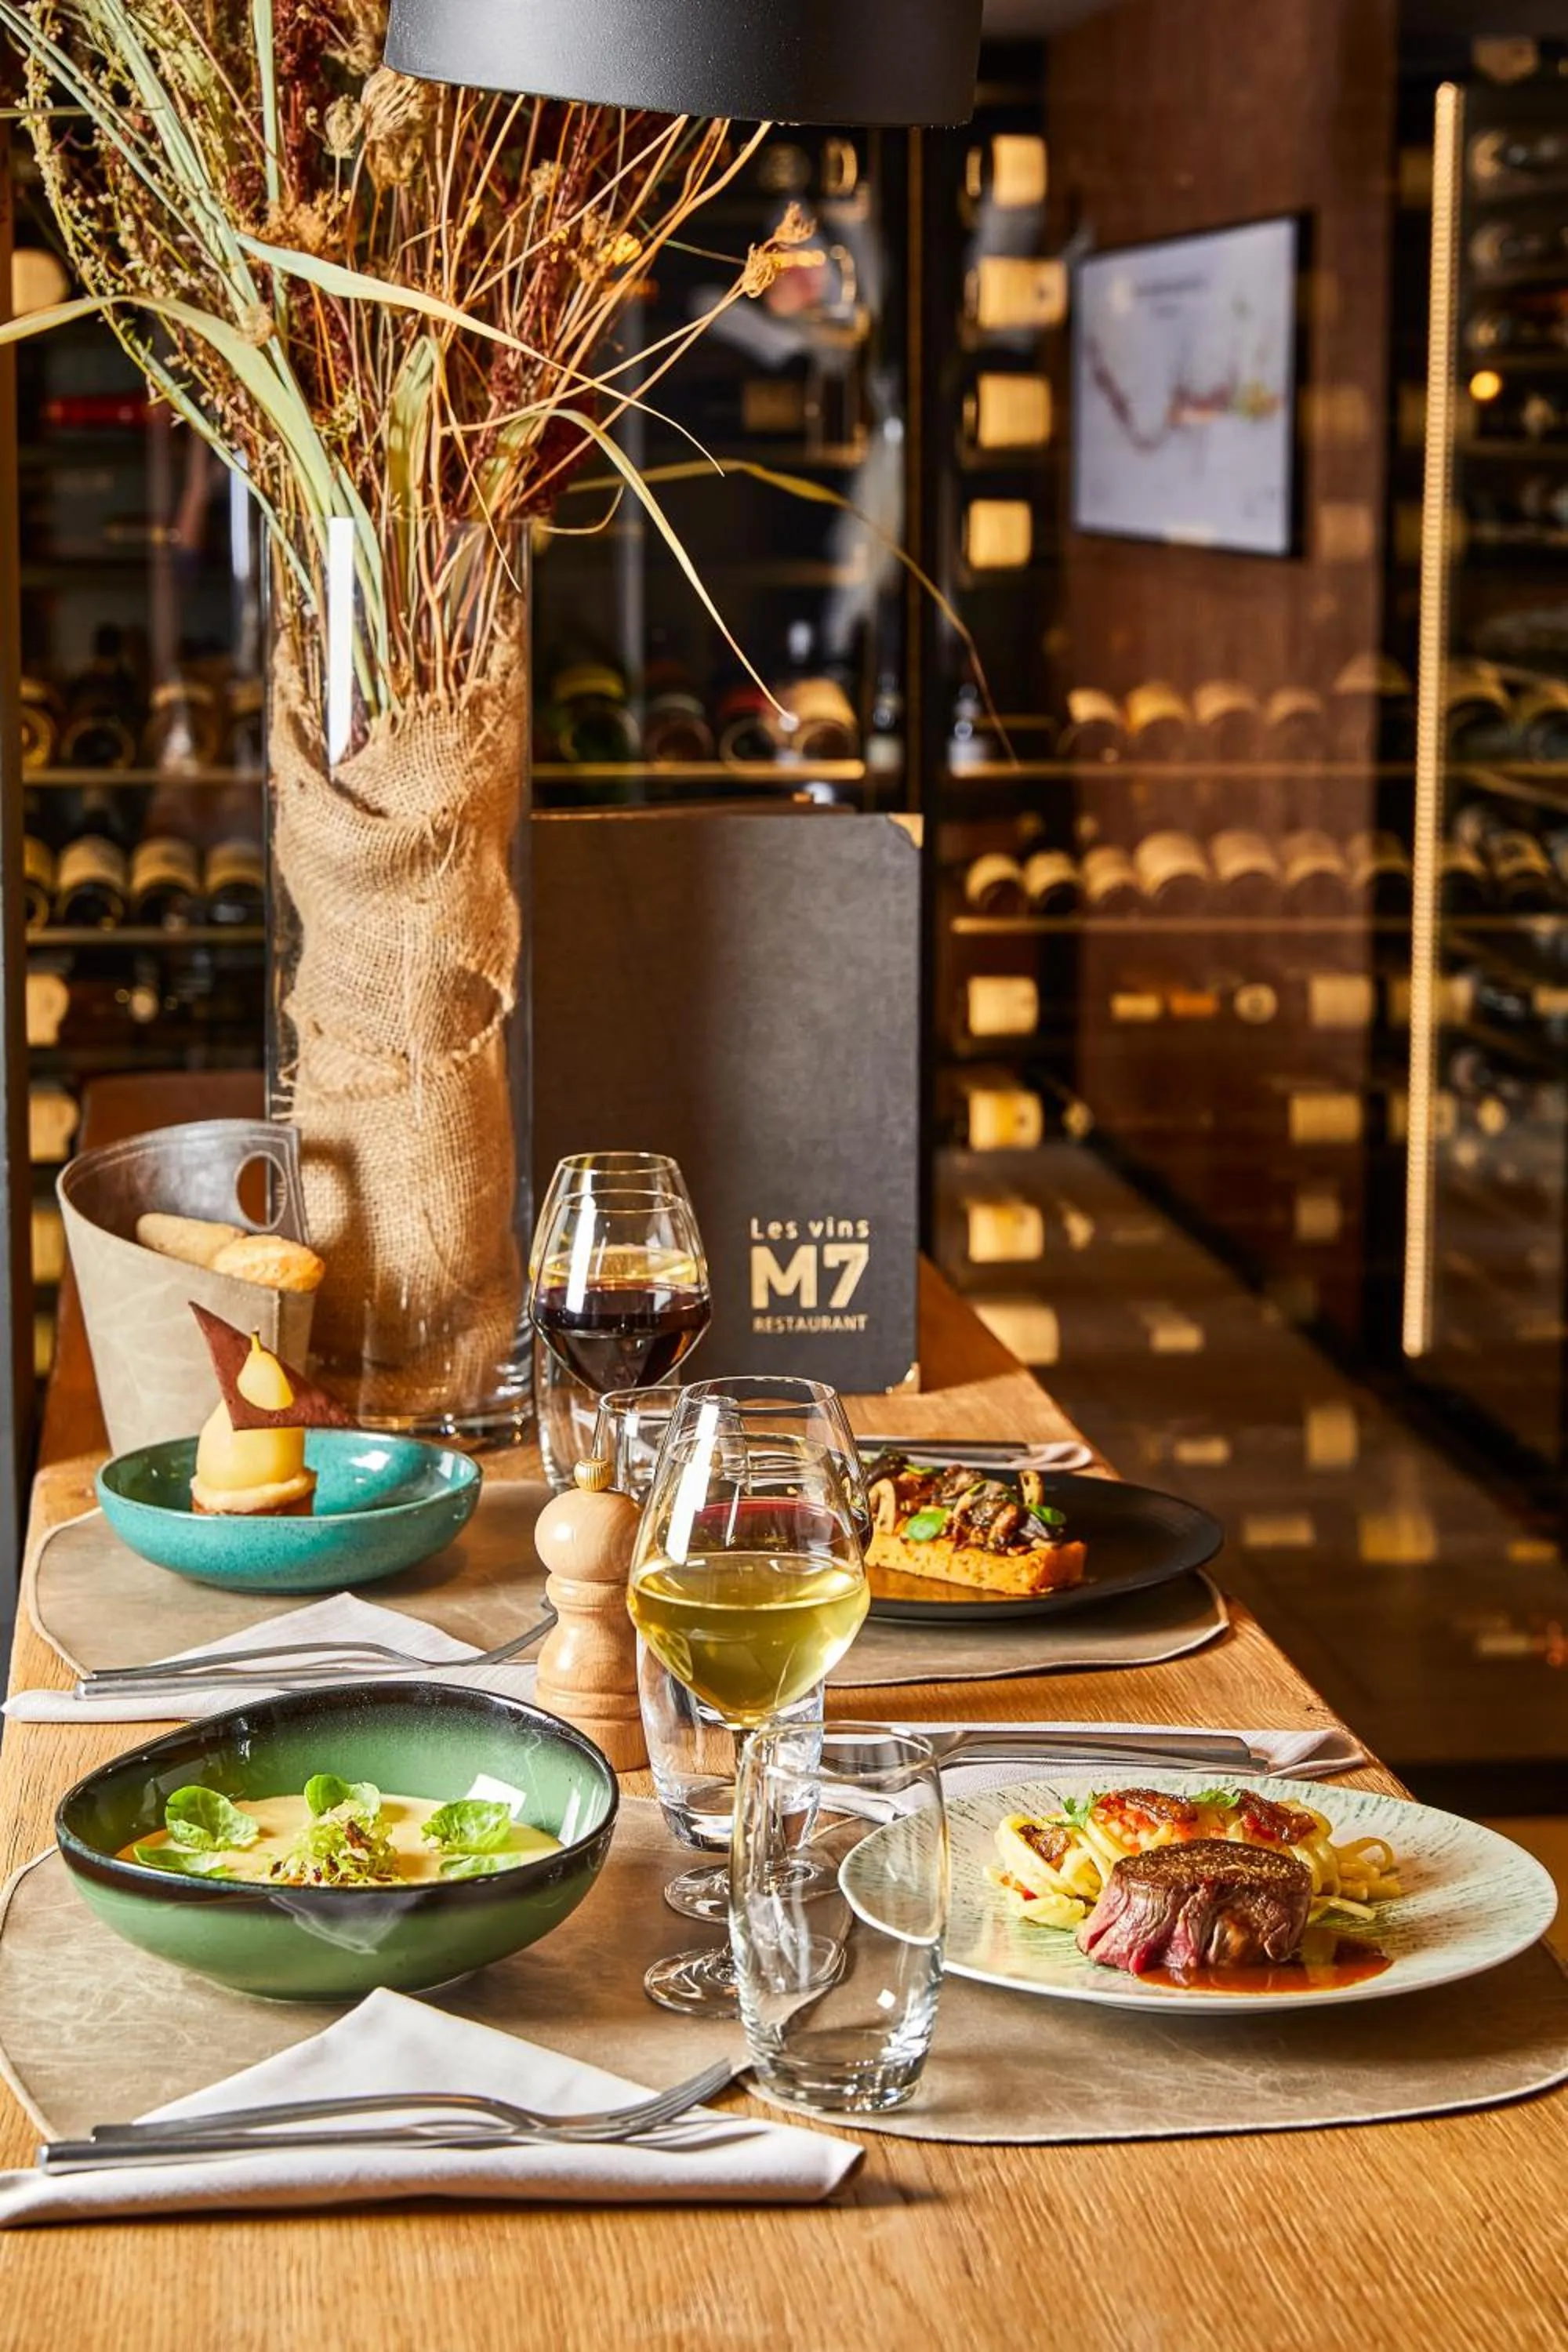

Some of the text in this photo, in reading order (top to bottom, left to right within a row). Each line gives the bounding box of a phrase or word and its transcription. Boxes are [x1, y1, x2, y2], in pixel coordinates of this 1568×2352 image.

[750, 1216, 869, 1240] Les vins
[750, 1243, 869, 1309] M7
[752, 1314, 868, 1334] RESTAURANT
